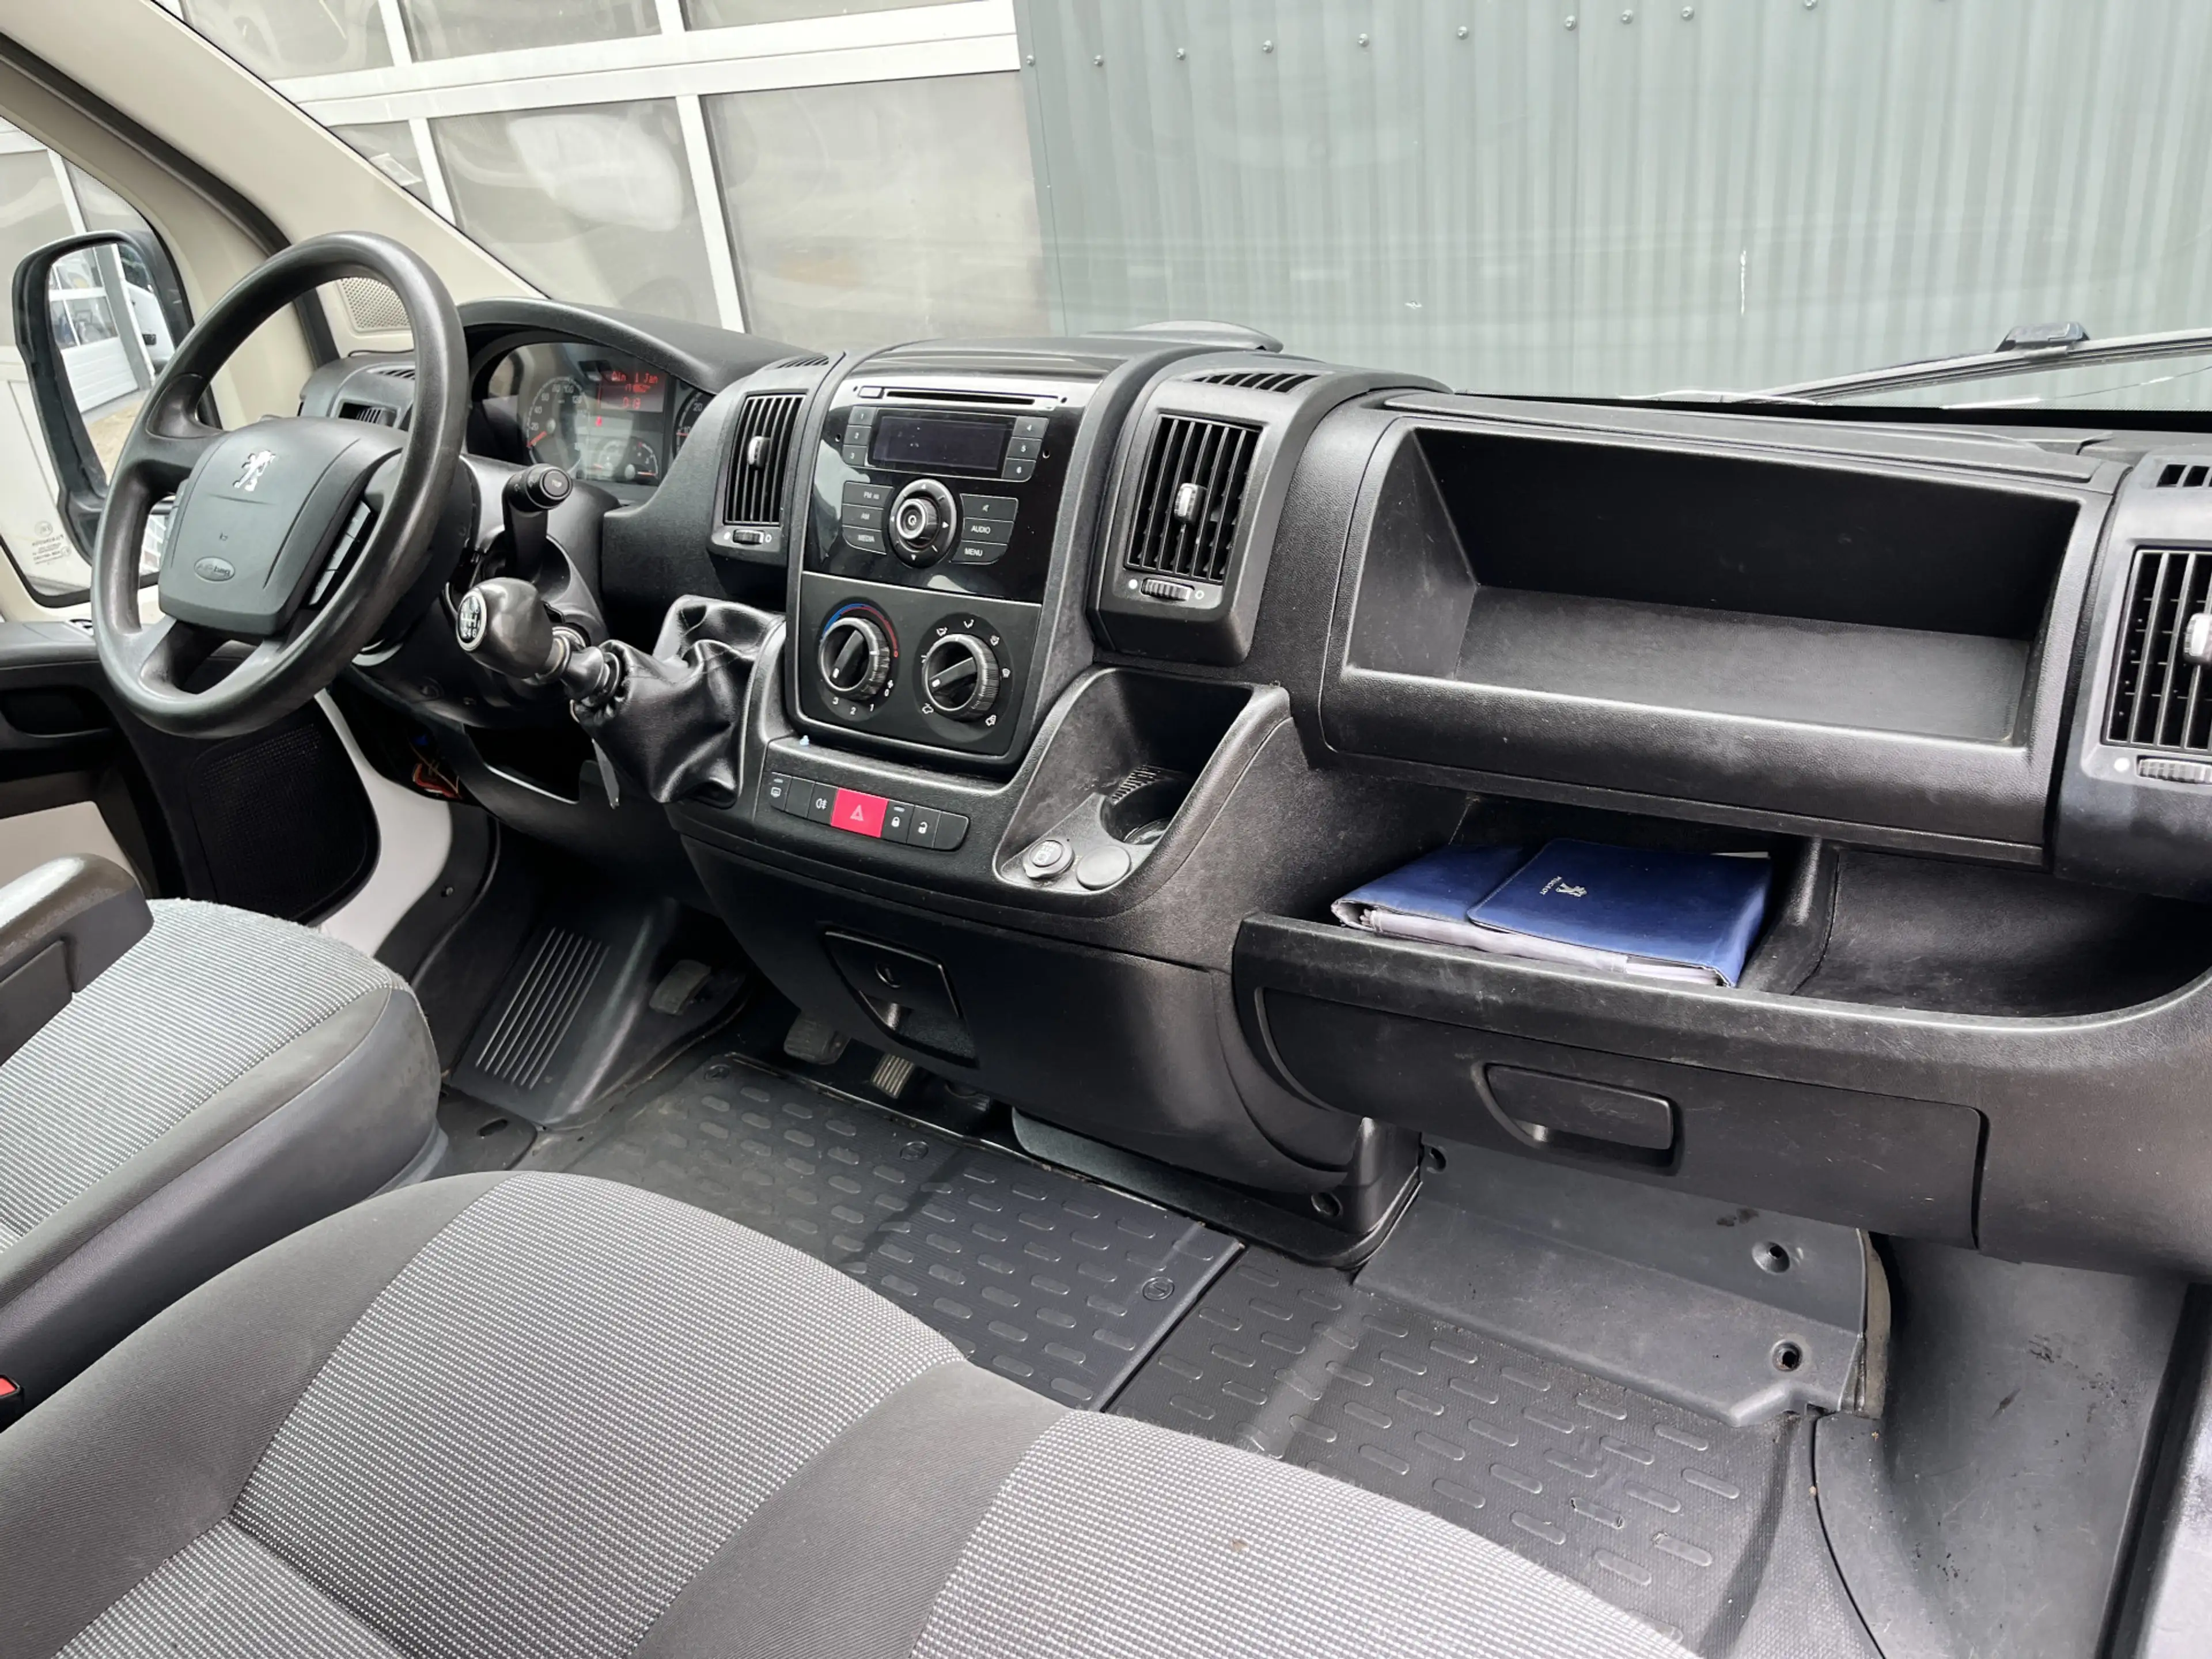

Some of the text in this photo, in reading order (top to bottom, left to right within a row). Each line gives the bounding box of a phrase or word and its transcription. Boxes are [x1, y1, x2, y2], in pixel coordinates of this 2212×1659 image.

[692, 403, 703, 412] 20
[861, 512, 870, 520] AM
[970, 525, 991, 535] AUDIO
[857, 534, 876, 543] MEDIA
[964, 547, 984, 557] MENU
[832, 696, 839, 705] 3
[850, 706, 857, 715] 2
[869, 703, 874, 712] 1
